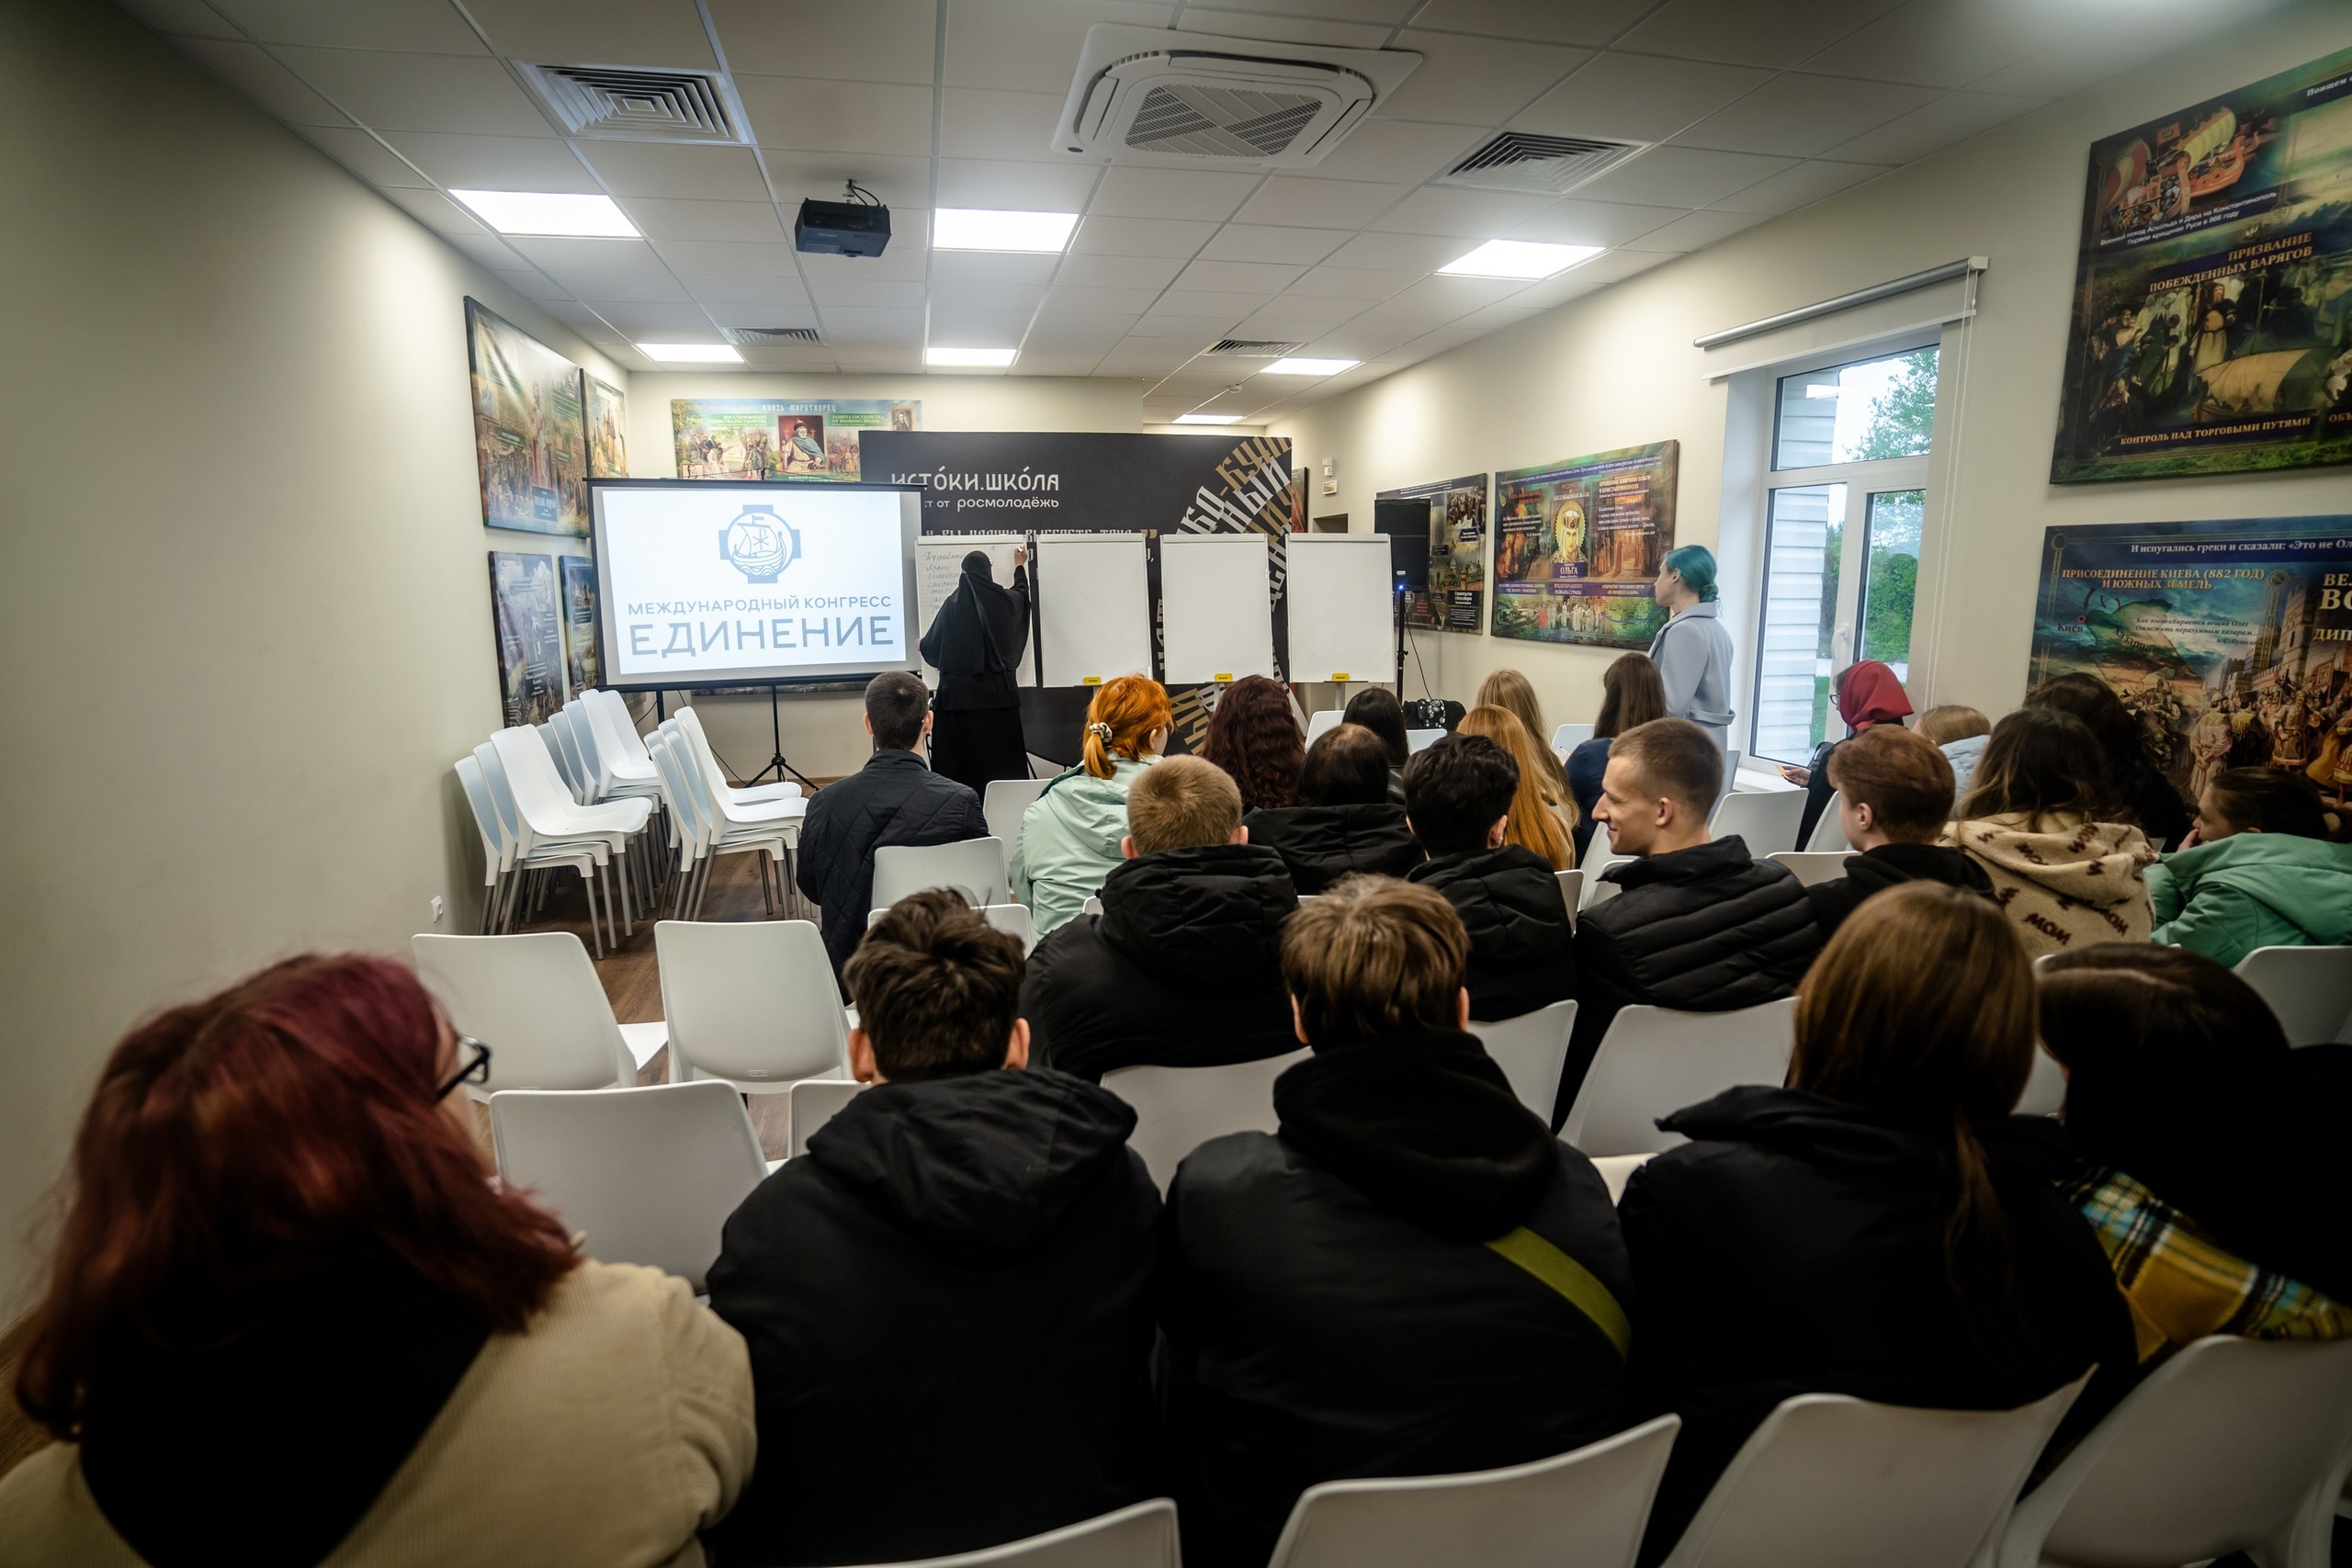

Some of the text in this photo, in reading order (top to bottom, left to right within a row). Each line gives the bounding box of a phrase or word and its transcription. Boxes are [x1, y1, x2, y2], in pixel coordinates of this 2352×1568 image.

[2100, 233, 2125, 246] Военный
[2126, 229, 2146, 239] поход
[2147, 220, 2178, 232] Аскольда
[2184, 213, 2202, 224] Дира
[2213, 191, 2278, 214] Константинополь
[2127, 234, 2151, 245] Первое
[2153, 227, 2185, 239] крещение
[2186, 220, 2202, 231] Руси
[2210, 215, 2222, 223] 866
[2222, 210, 2239, 220] году
[2228, 231, 2312, 261] ПРИЗВАНИЕ
[2149, 246, 2313, 293] ПОБЕЖДЕННЫХ ВАРЯГОВ
[2120, 417, 2312, 446] КОНТРОЛЬ НАД ТОРГОВЫМИ ПУТЯМИ
[957, 496, 1058, 512] росмолодёжь
[2131, 545, 2139, 553] И
[2141, 545, 2195, 554] испугались
[2197, 545, 2227, 553] греки
[2238, 542, 2286, 550] сказали:
[2288, 540, 2316, 549] «Это
[2062, 569, 2265, 581] ПРИСОЕДИНЕНИЕ КИЕВА (882 ГОД)
[2102, 580, 2212, 590] И ЮЖНЫХ ЗЕМЕЛЬ
[628, 594, 891, 615] МЕЖДУНАРОДНЫЙ КОНГРЕСС
[2057, 623, 2083, 633] Киев
[2168, 617, 2205, 626] сбирается
[2207, 619, 2230, 627] вещий
[2231, 620, 2248, 628] Олег
[2176, 626, 2219, 635] неразумным
[629, 615, 894, 659] ЕДИНЕНИЕ
[2113, 626, 2153, 653] Хазария
